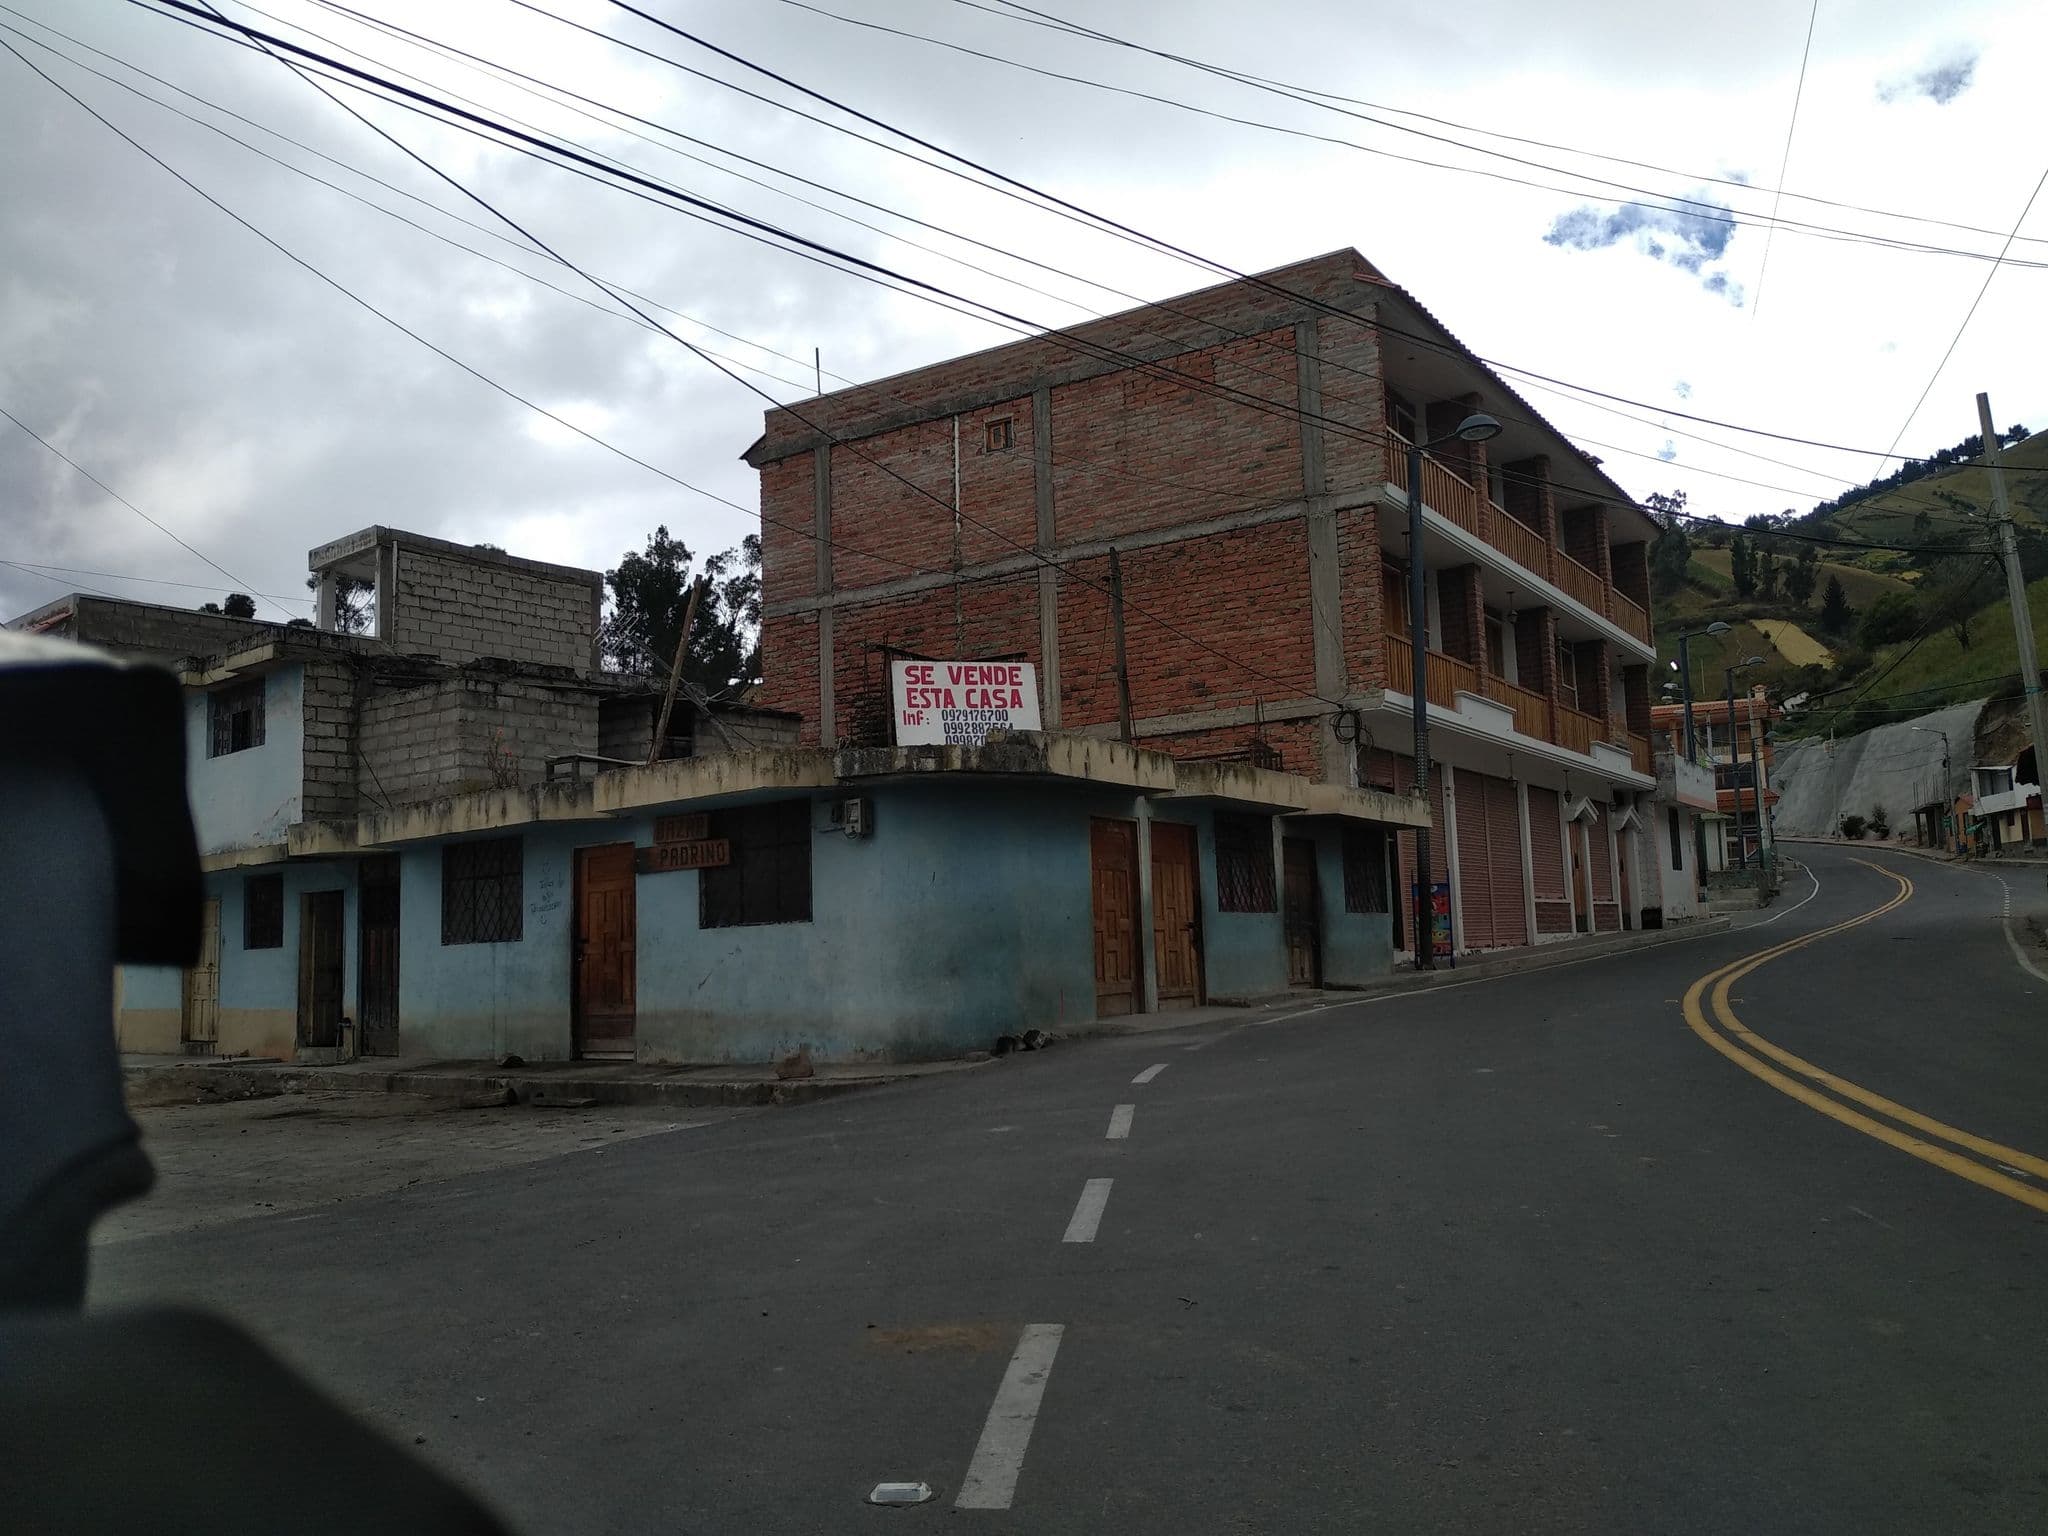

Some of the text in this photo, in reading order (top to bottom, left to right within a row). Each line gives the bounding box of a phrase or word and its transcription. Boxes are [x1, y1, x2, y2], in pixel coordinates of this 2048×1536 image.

[905, 666, 1023, 686] SE VENDE
[906, 688, 1023, 709] ESTA CASA
[941, 709, 1009, 722] 0979176700
